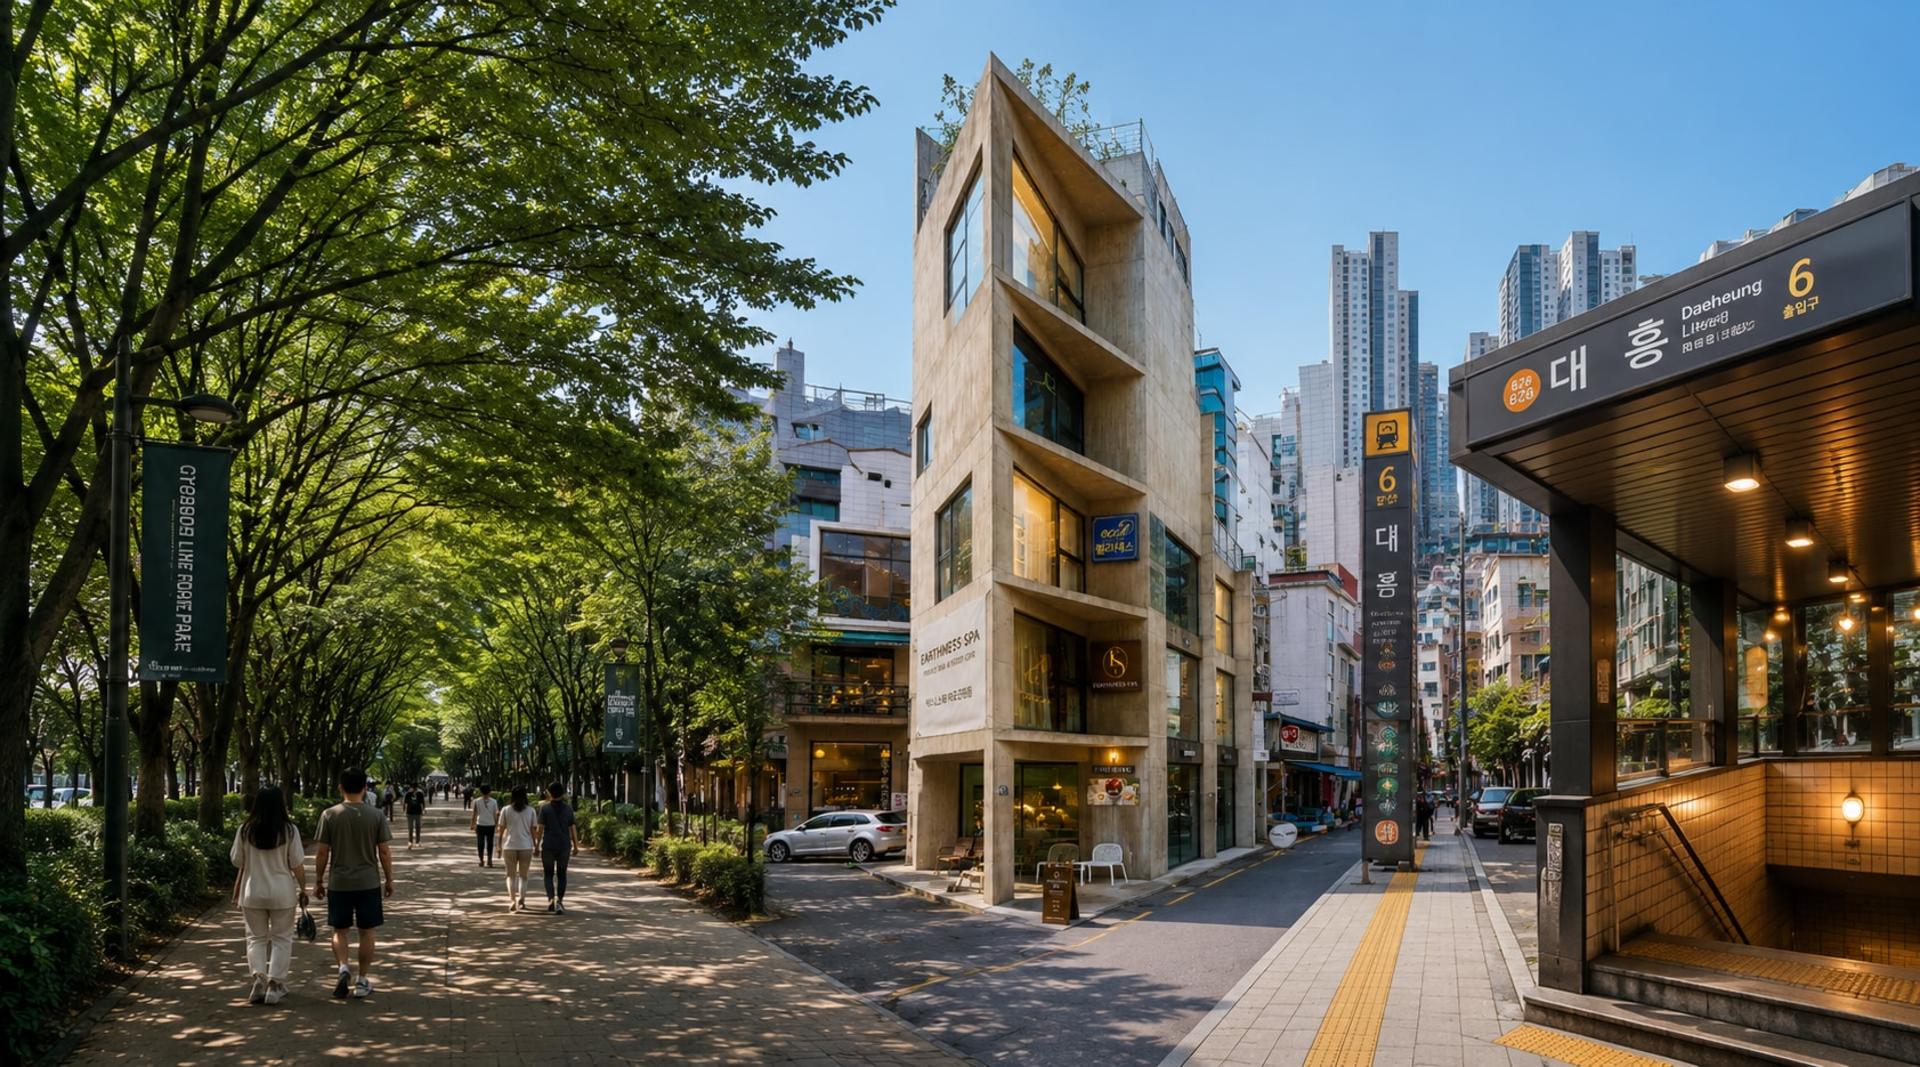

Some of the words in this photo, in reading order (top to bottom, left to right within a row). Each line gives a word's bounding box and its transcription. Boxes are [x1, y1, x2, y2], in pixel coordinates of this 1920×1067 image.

[1788, 258, 1815, 298] 6
[1681, 279, 1763, 321] Daeheung
[1782, 296, 1821, 320] 출입구
[1378, 465, 1397, 493] 6
[963, 629, 980, 647] SPA
